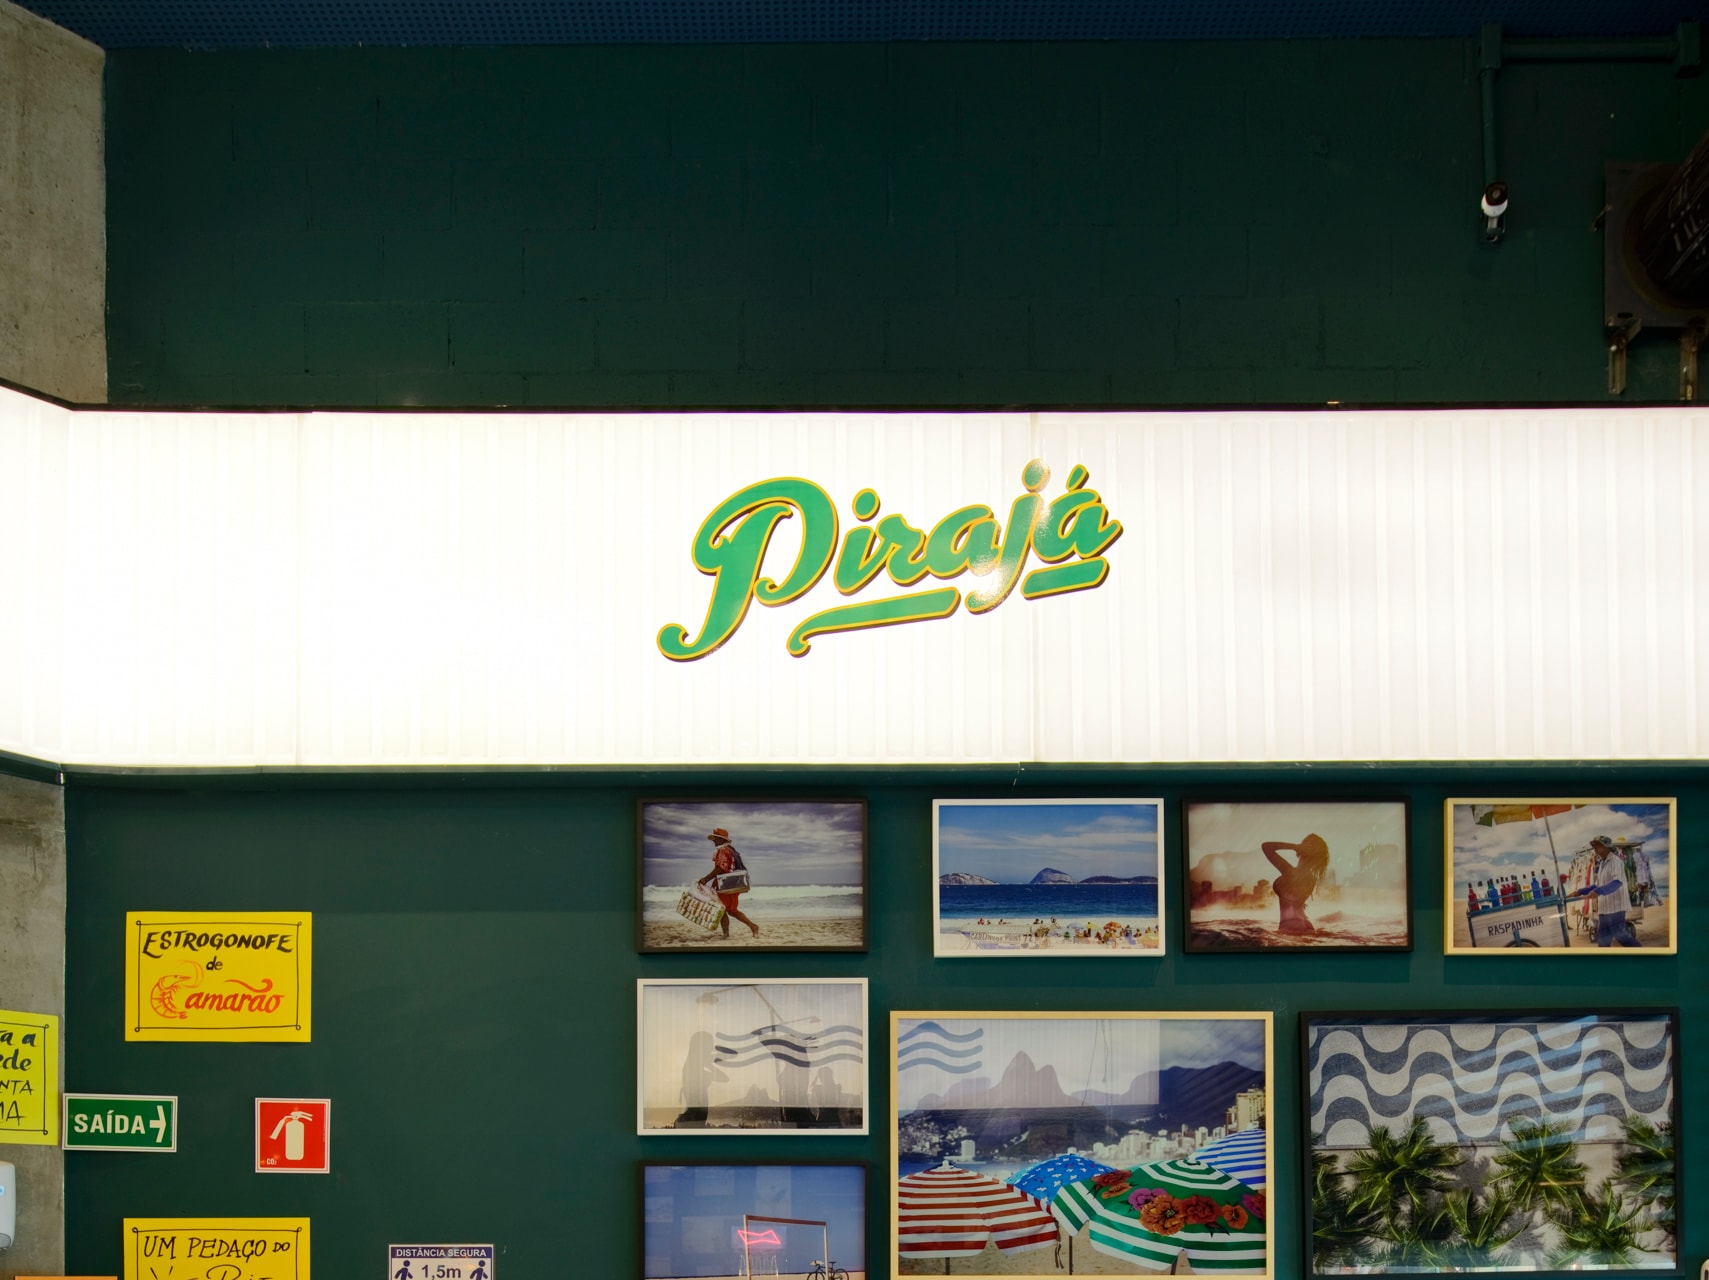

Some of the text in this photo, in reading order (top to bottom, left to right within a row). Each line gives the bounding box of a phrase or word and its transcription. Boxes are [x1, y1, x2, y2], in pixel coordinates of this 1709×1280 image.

[656, 458, 1124, 662] Pirajá
[1487, 916, 1544, 937] RASPADINHA
[142, 930, 294, 959] ESTROGONOFE
[206, 955, 223, 971] de
[0, 1030, 39, 1047] a a
[0, 1048, 32, 1071] de
[0, 1079, 35, 1096] NTA
[74, 1110, 146, 1134] SAÍDA
[144, 1236, 291, 1263] UM PEDAÇO DO
[396, 1247, 487, 1257] DISTÂNCIA SEGURA
[421, 1264, 462, 1280] 1,5m
